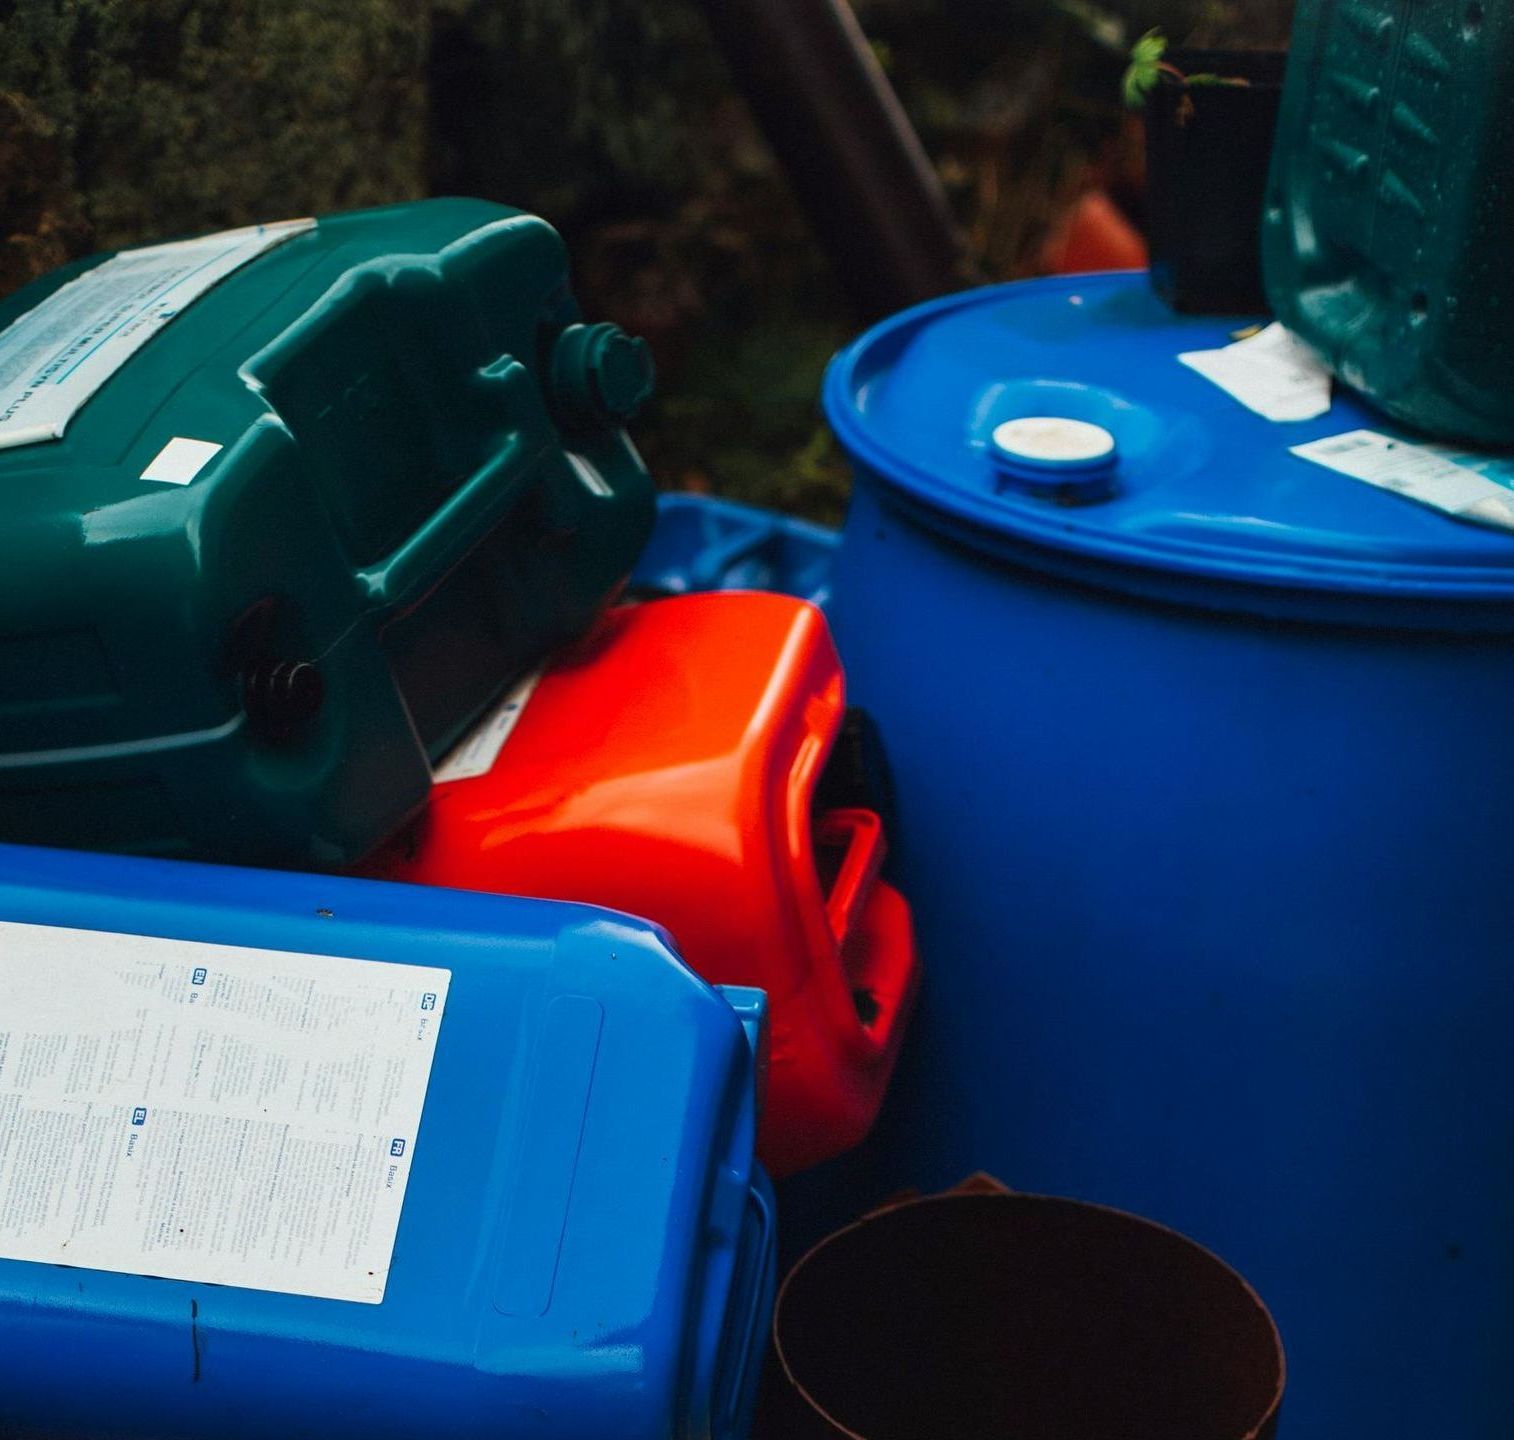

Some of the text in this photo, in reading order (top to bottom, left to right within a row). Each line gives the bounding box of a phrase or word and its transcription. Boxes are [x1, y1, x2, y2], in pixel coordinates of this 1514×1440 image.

[0, 391, 33, 421] PLUS
[193, 969, 206, 984] EN
[126, 1108, 146, 1157] EL Basix
[386, 1139, 405, 1189] FR Basix
